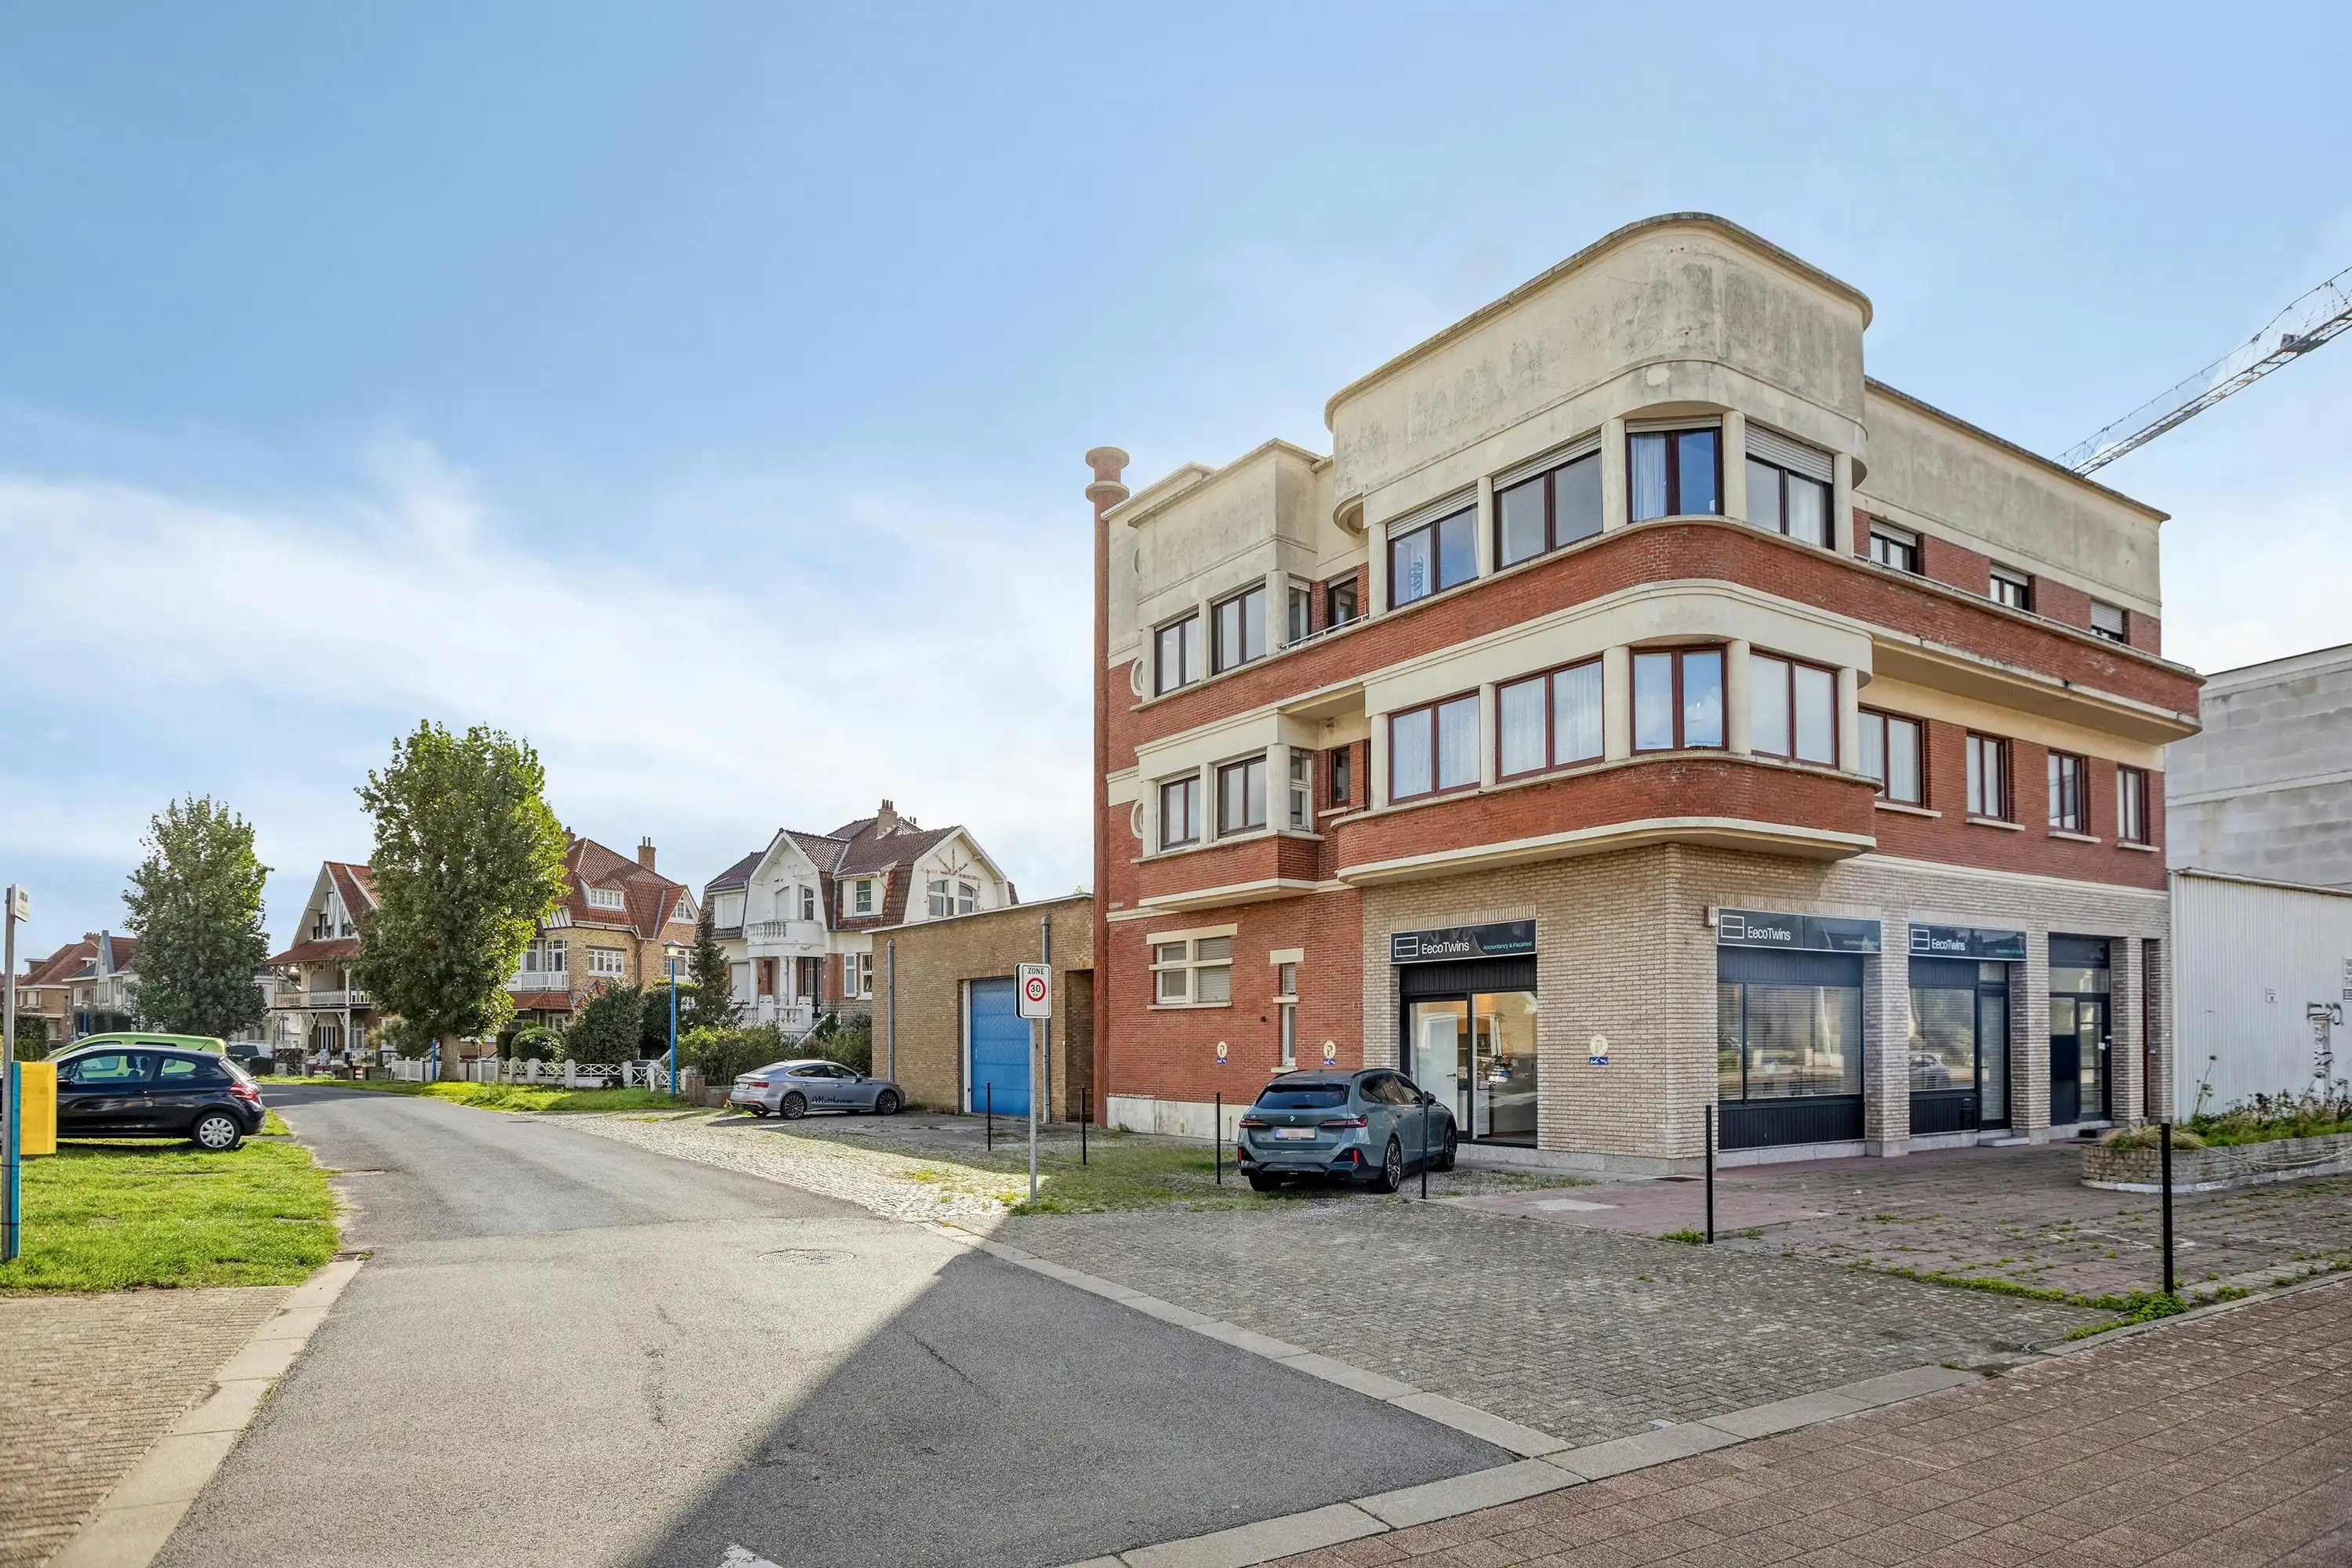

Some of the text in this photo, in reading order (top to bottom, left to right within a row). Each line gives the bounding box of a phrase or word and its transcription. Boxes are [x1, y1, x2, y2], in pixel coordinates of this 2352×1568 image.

[1748, 927, 1791, 942] EecoTwins
[1421, 940, 1470, 955] EecoTwins
[1932, 938, 1965, 951] EecoTwins
[1030, 984, 1041, 993] 30
